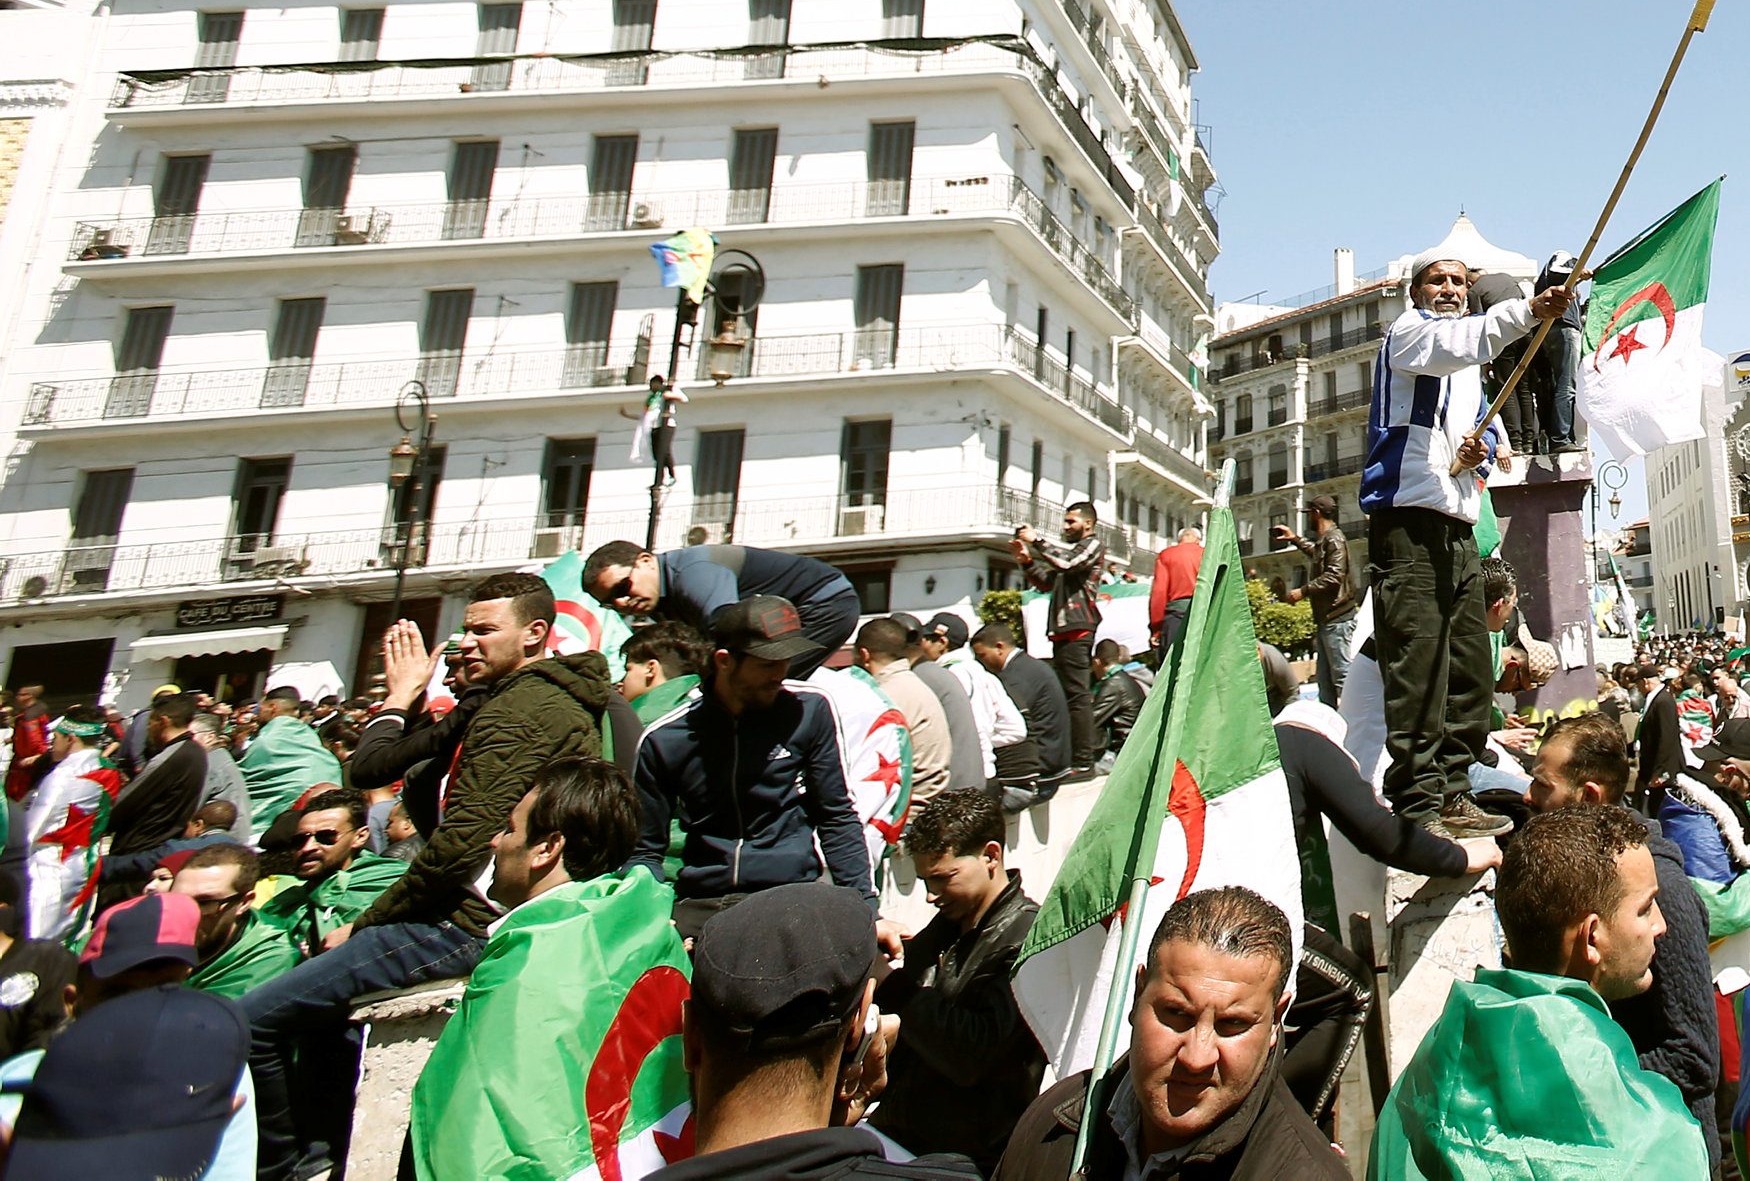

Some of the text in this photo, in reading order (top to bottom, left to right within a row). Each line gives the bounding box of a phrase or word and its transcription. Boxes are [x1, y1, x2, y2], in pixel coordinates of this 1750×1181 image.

[210, 605, 229, 616] DU
[230, 601, 278, 615] CENTRE
[1311, 956, 1350, 986] JUVENTUS
[1331, 1025, 1361, 1083] JUVENTUS
